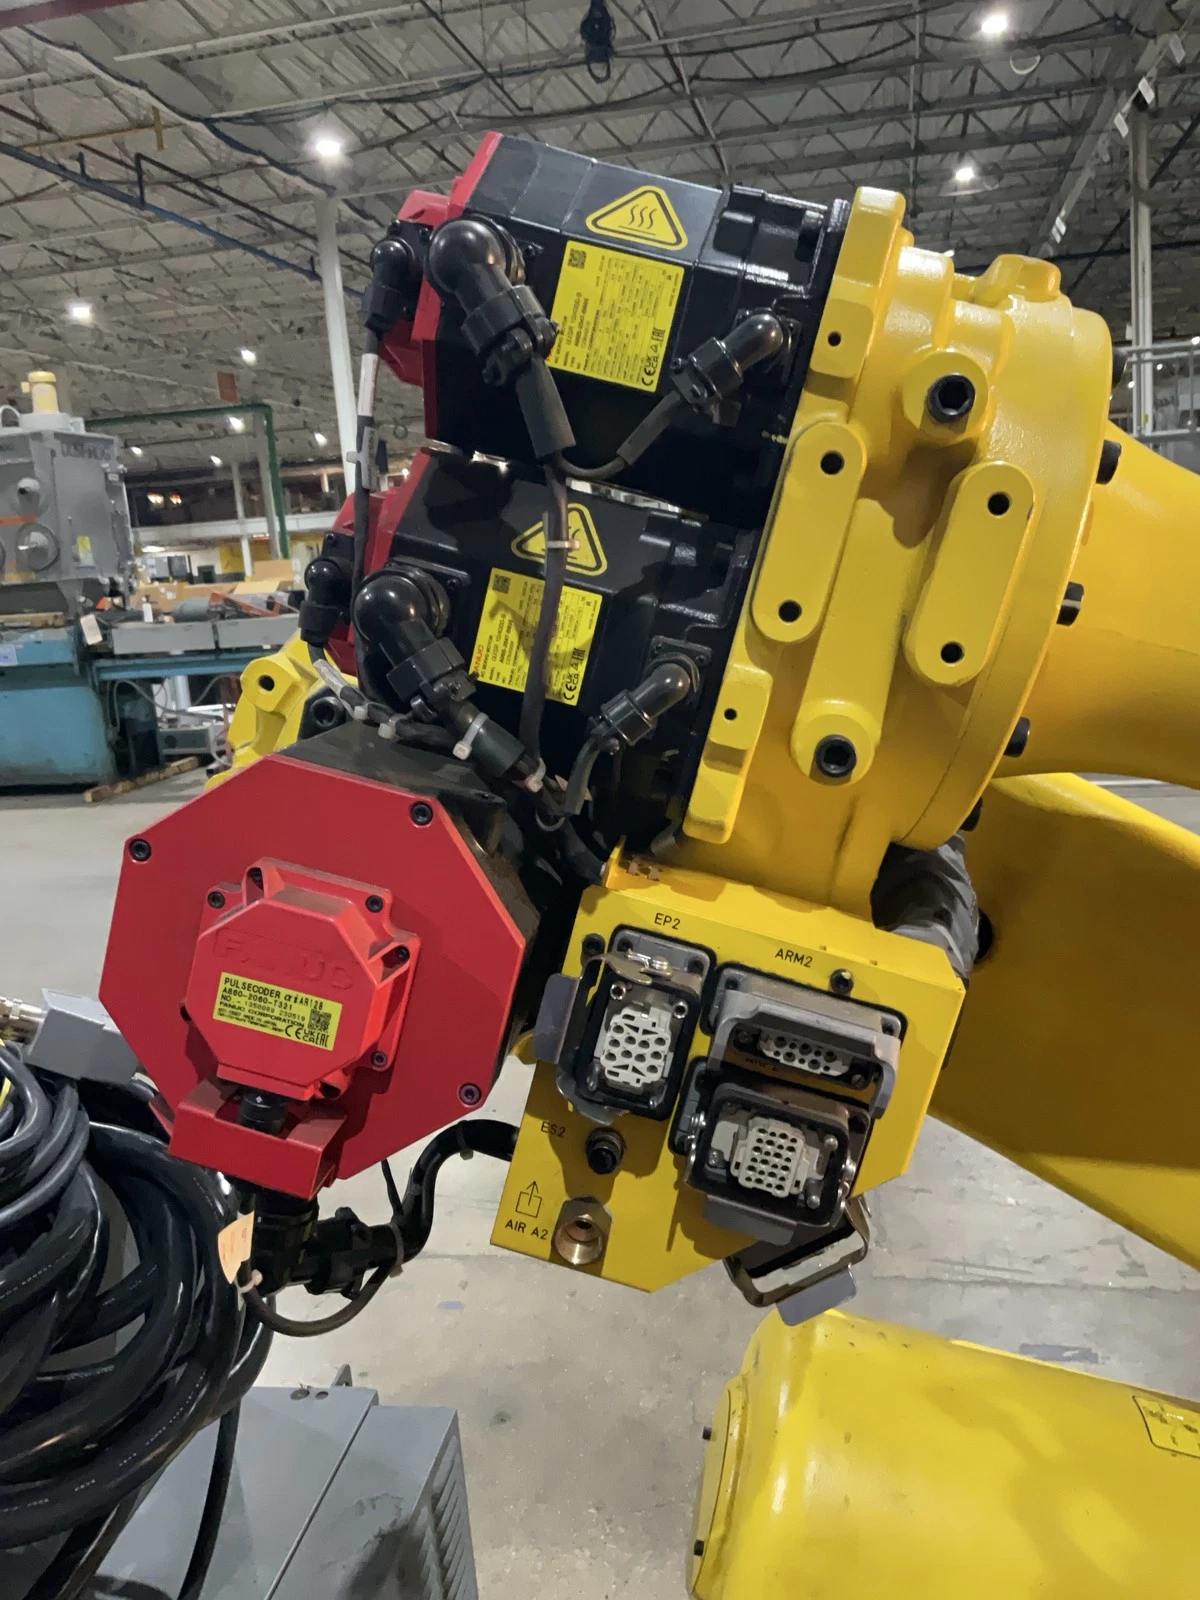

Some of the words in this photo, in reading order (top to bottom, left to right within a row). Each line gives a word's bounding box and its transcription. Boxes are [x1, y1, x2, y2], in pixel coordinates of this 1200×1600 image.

[654, 912, 681, 930] EP2
[775, 948, 813, 968] ARM2
[223, 986, 292, 1010] A860-2060-T321
[224, 977, 280, 999] PULSECODER
[220, 1001, 245, 1011] FANUC
[249, 1009, 304, 1027] CORPORATION
[541, 1121, 565, 1138] ES2
[505, 1219, 526, 1233] AIR
[531, 1227, 548, 1240] A2
